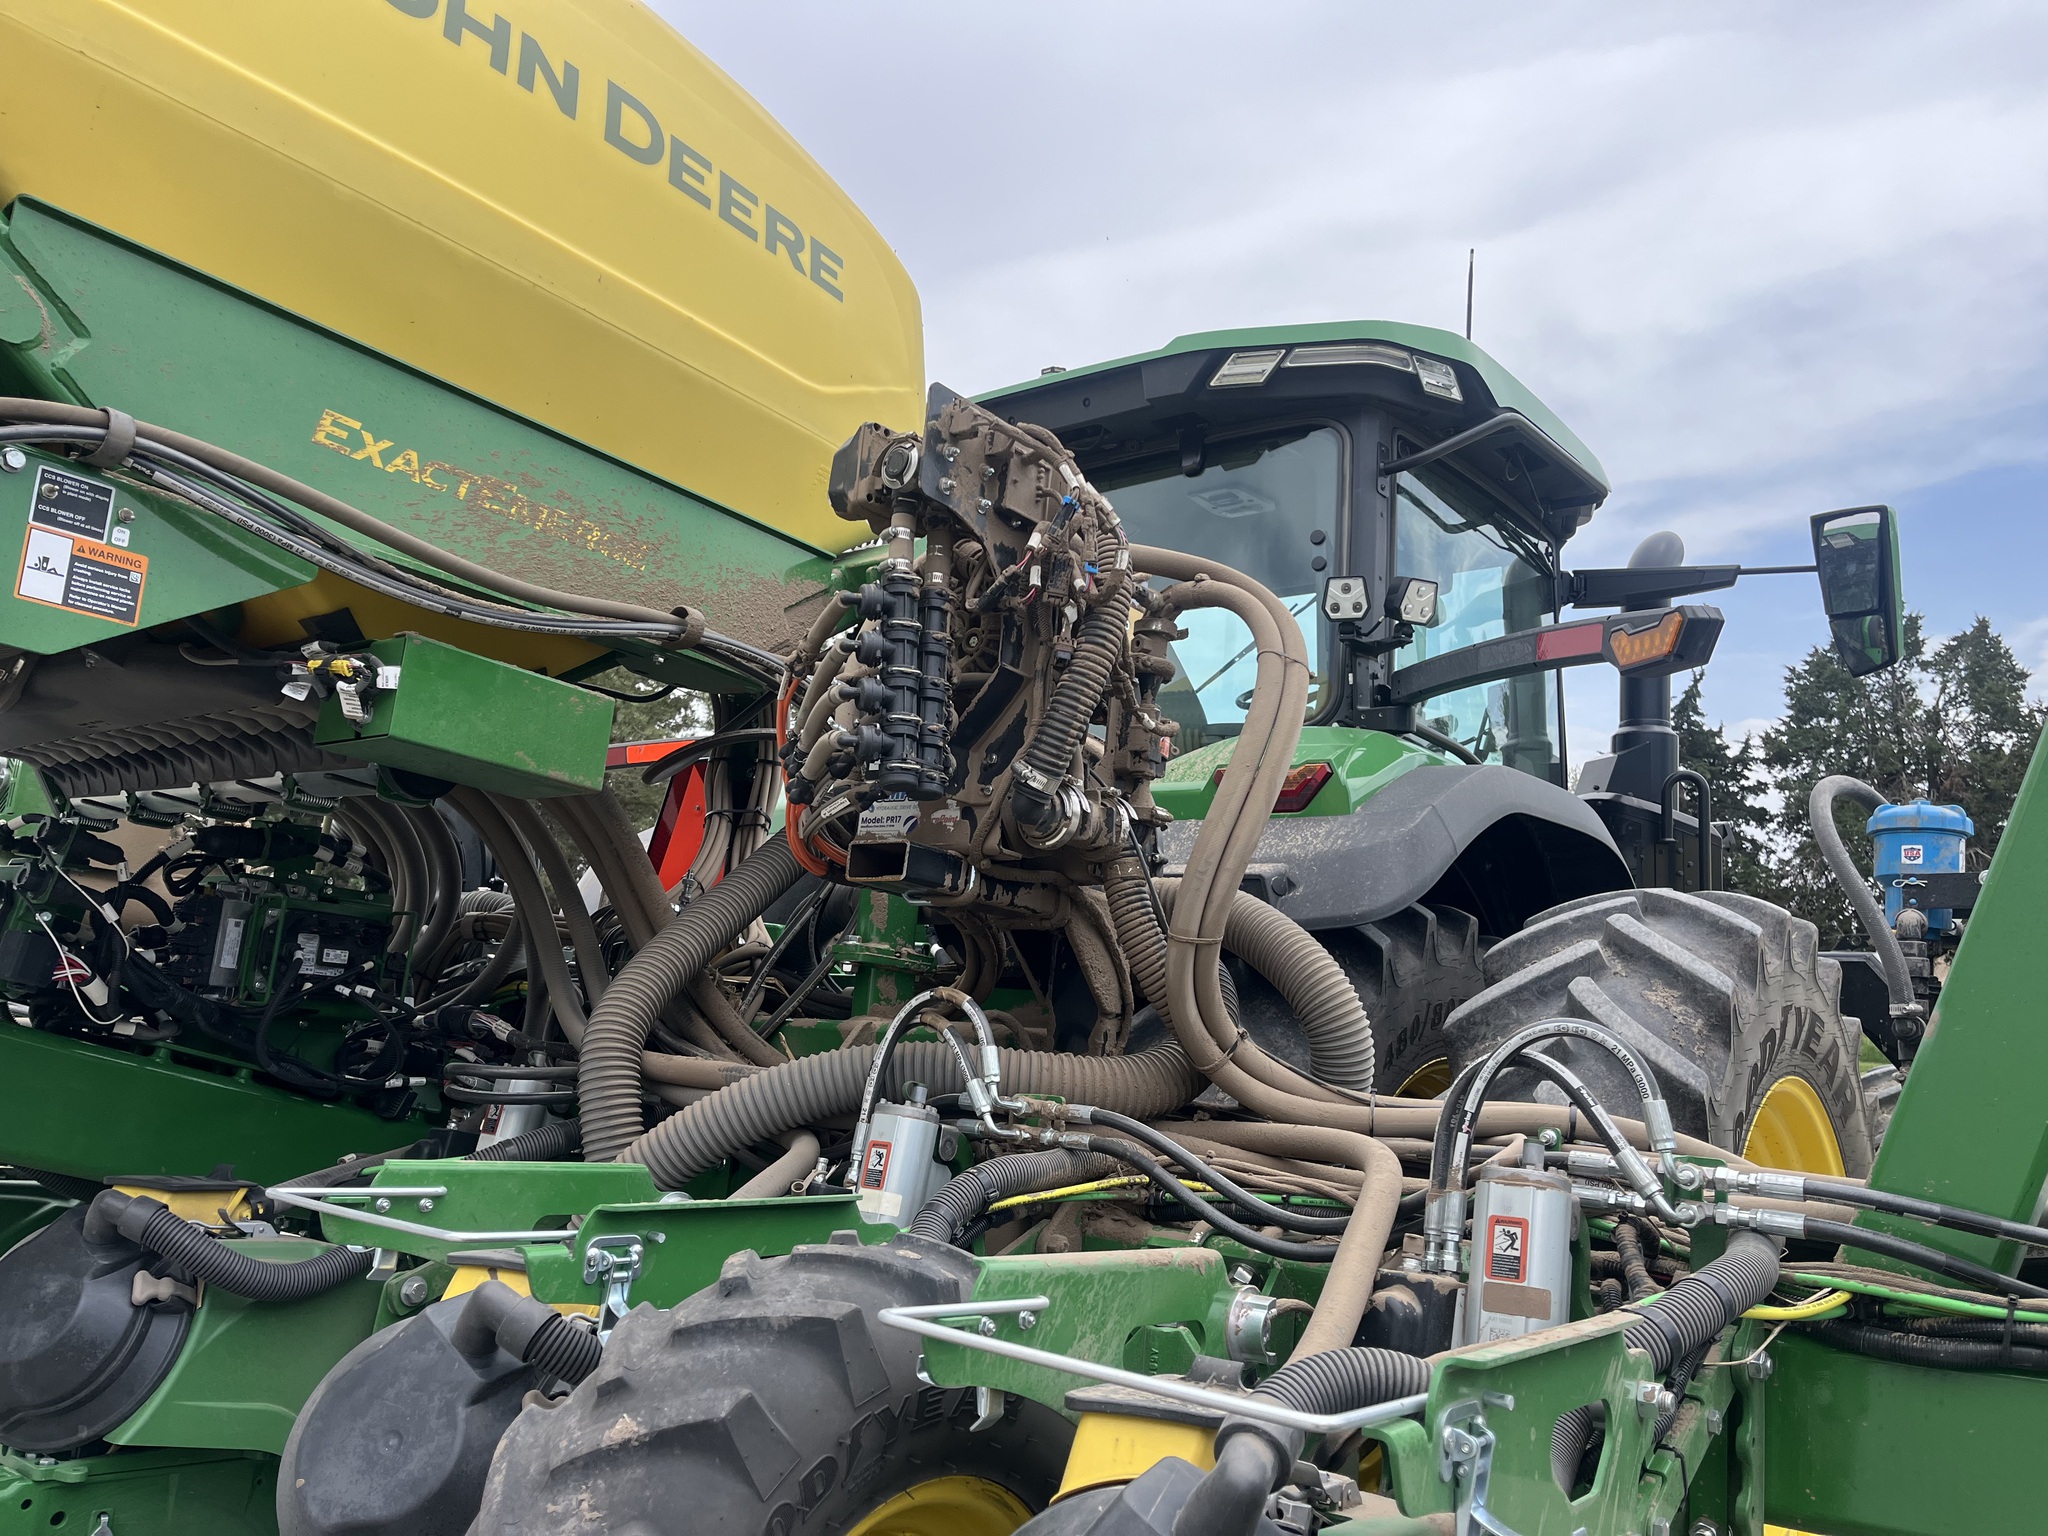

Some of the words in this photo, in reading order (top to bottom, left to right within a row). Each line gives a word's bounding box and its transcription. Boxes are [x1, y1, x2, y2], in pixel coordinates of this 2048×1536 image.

[386, 0, 580, 121] HN
[604, 78, 844, 303] DEERE
[44, 472, 56, 480] CCS
[57, 475, 80, 487] BLOWER
[80, 482, 89, 490] ON
[38, 504, 50, 512] CCS
[50, 507, 74, 518] BLOWER
[236, 516, 253, 530] PSI)
[254, 525, 276, 542] (3000
[277, 537, 294, 551] MPa
[88, 546, 142, 569] WARNING
[295, 547, 306, 556] 21
[87, 565, 104, 573] serious
[70, 586, 98, 597] maintenance
[86, 585, 110, 595] performing
[87, 598, 110, 607] Operator's
[861, 816, 885, 824] Model:
[885, 815, 902, 823] PR17
[1904, 849, 1921, 857] USA
[951, 1041, 958, 1052] 21
[954, 1050, 963, 1066] MPa
[1610, 1044, 1622, 1057] 21
[1620, 1053, 1637, 1074] MPa
[1634, 1072, 1650, 1100] (3000
[1733, 1003, 1857, 1157] OODYEAR
